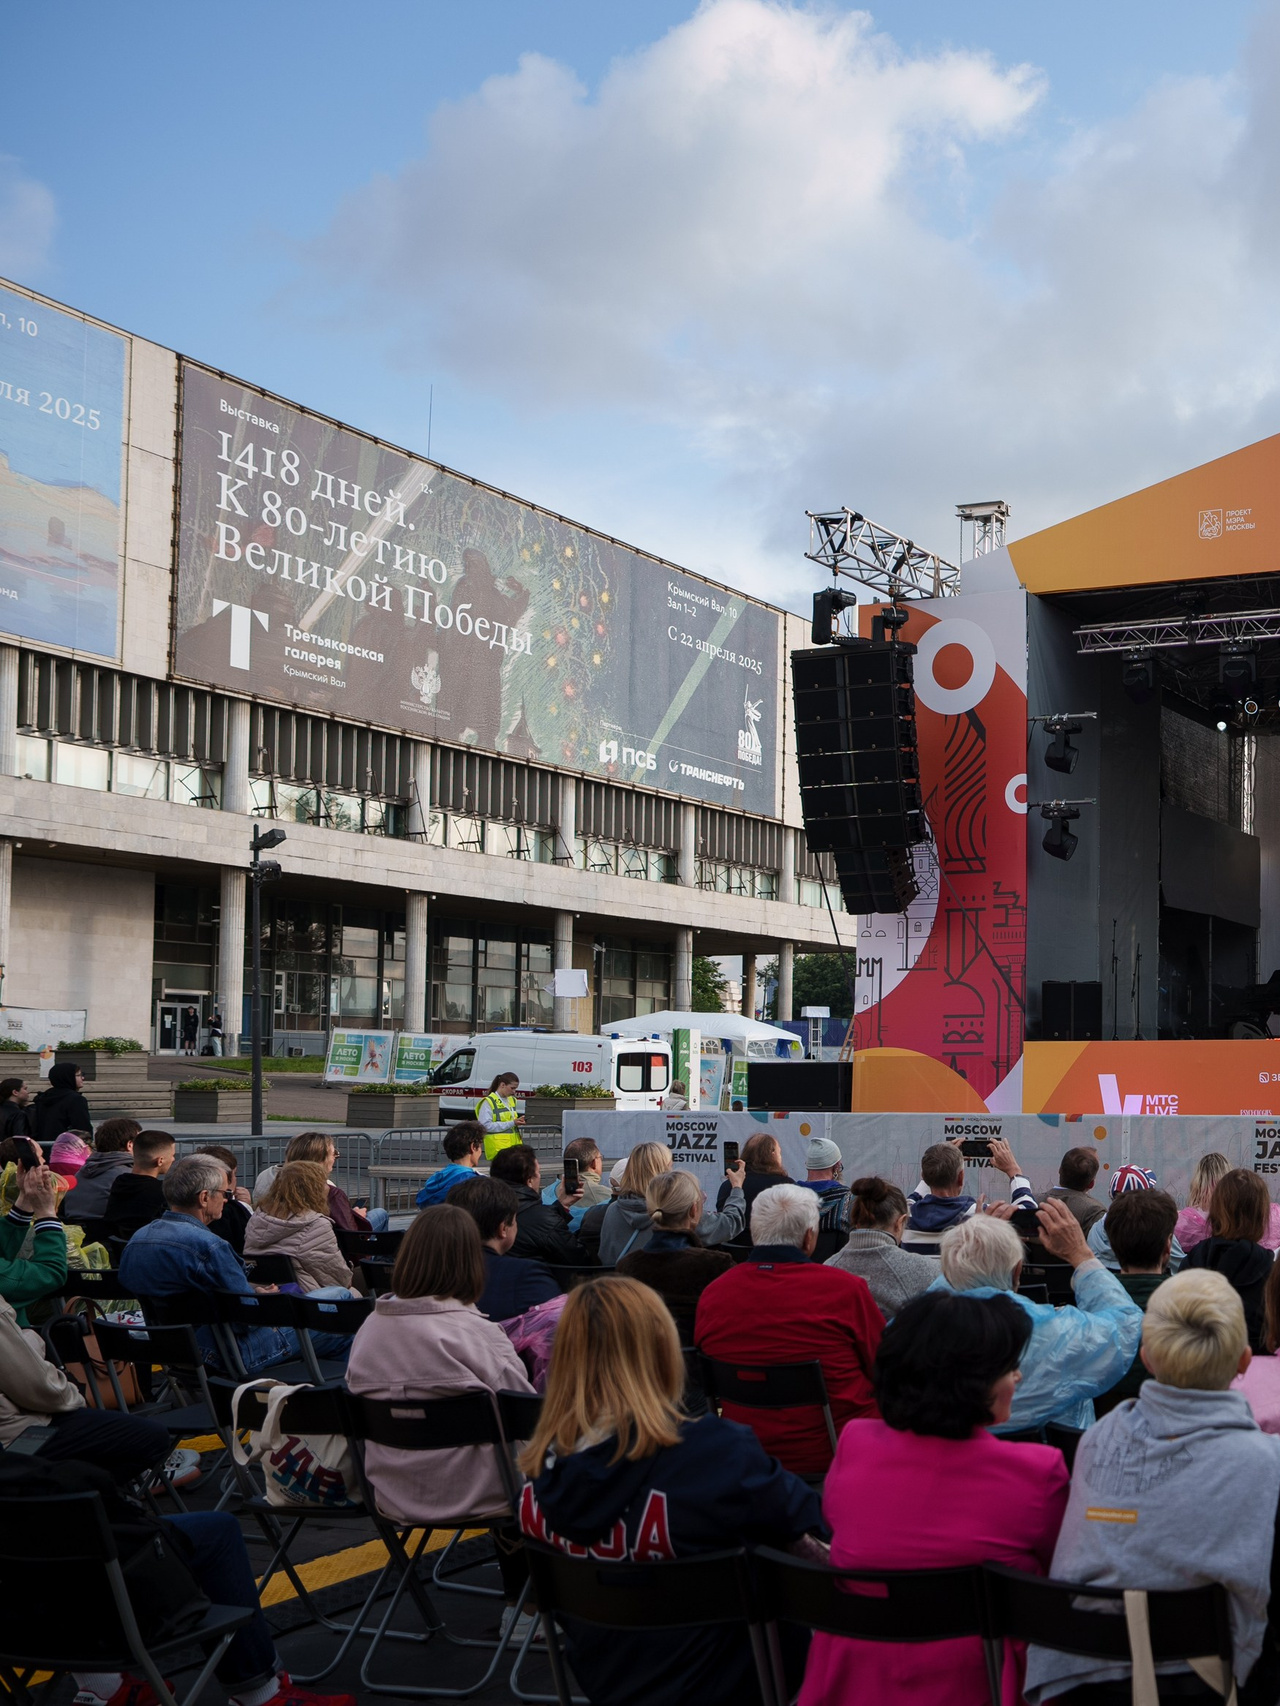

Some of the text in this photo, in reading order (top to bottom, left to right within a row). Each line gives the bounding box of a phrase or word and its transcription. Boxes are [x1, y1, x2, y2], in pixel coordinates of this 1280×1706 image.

[19, 318, 38, 337] 10
[39, 392, 100, 430] 2025
[220, 399, 279, 434] Выставка
[217, 430, 415, 531] 1418 дней.
[420, 482, 434, 495] 12+
[1226, 508, 1252, 517] ПРОЕКТ
[216, 471, 447, 584] К 80-летию
[1226, 523, 1256, 531] МОСКВЫ
[214, 521, 533, 655] Великой Победы
[667, 581, 738, 618] Крымский Вал, 10
[667, 597, 681, 611] Зал
[284, 623, 384, 663] Третьяковская
[668, 626, 763, 676] С 22 апреля 2025
[284, 646, 341, 670] галерея
[283, 664, 346, 688] Крымский Вал
[738, 729, 752, 748] 80
[622, 747, 657, 770] ПСБ
[738, 750, 762, 765] ПОБЕДА!
[680, 763, 745, 790] ТРАНСНЕФТЬ
[336, 1048, 358, 1057] ЛЕТО
[402, 1052, 426, 1061] ЛЕТО
[571, 1061, 593, 1073] 103
[1145, 1105, 1179, 1115] LIVE
[666, 1121, 718, 1131] MOSCOW
[944, 1124, 1002, 1135] MOSCOW
[667, 1133, 718, 1150] JAZZ
[672, 1153, 717, 1162] ESTIVAL
